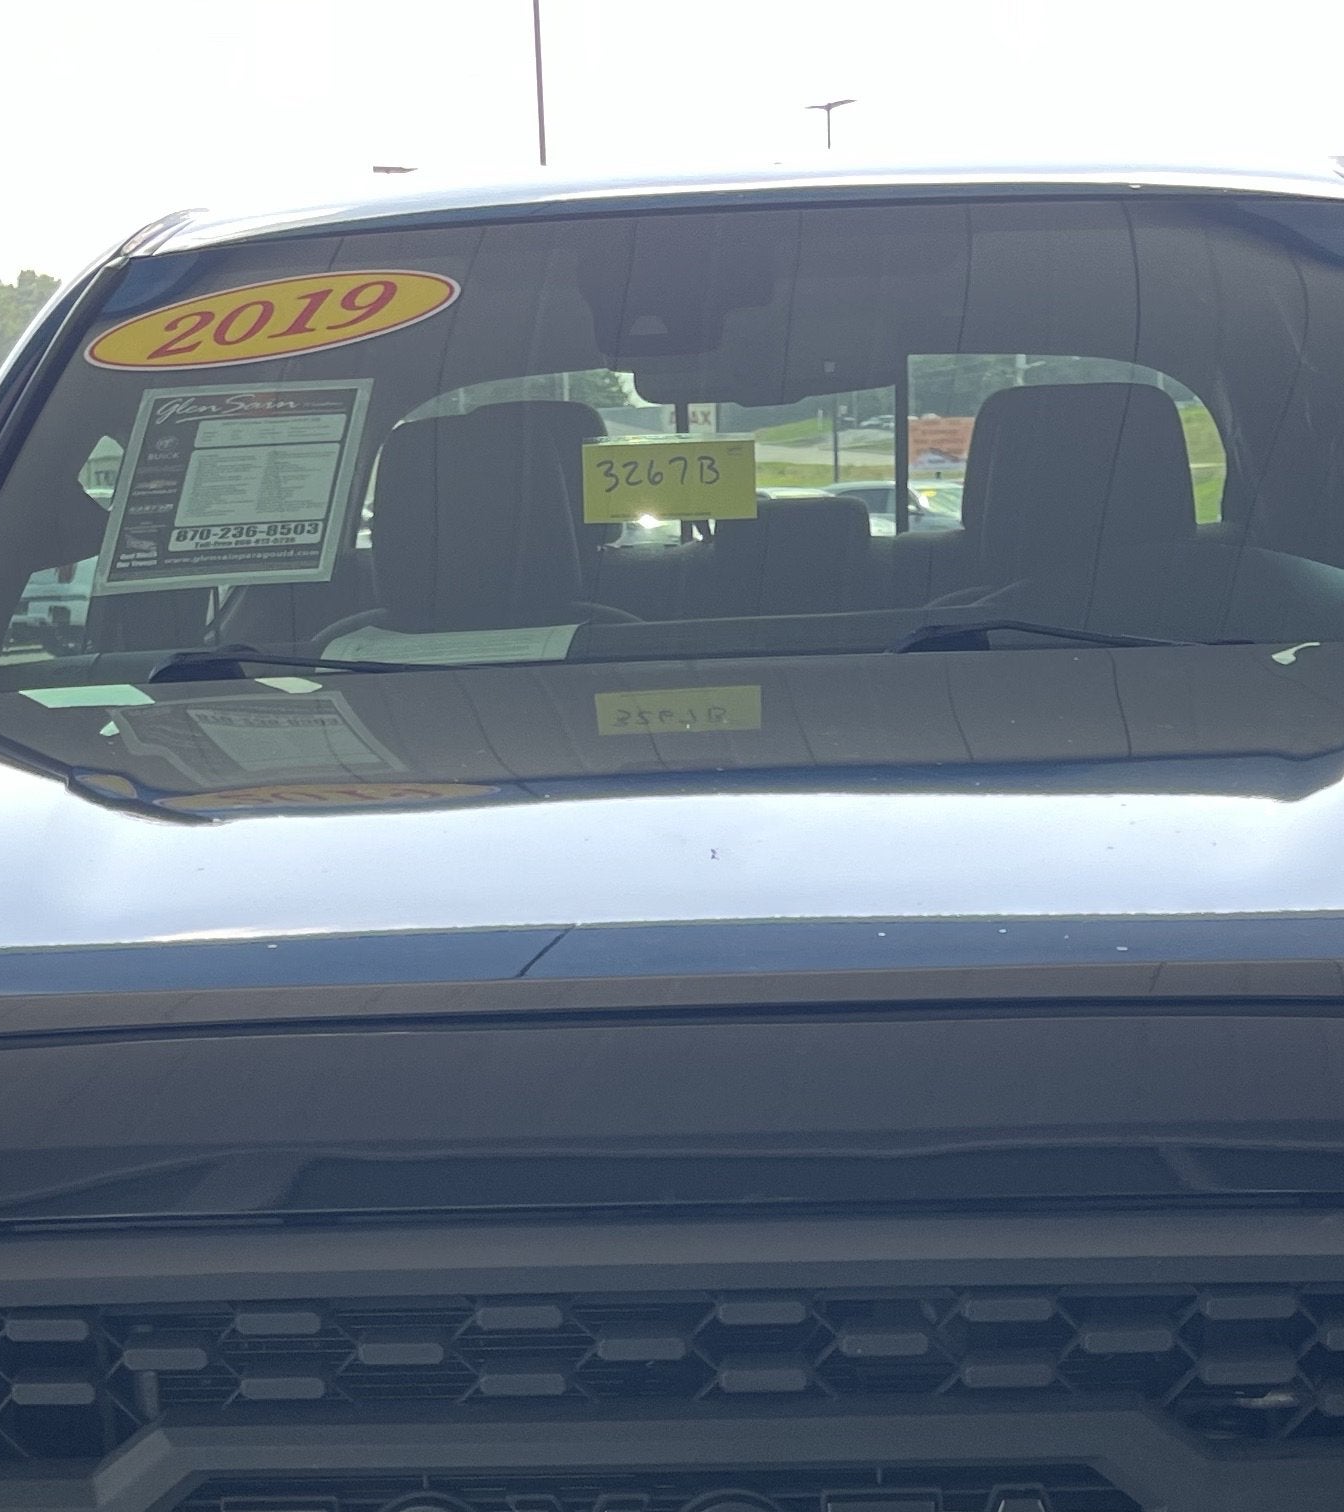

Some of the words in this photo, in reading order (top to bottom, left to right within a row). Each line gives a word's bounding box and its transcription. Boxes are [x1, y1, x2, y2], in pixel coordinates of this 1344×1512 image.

[147, 281, 398, 360] 2019
[156, 397, 222, 424] Glen
[596, 456, 720, 493] 3267B
[175, 521, 320, 541] 870-236-8503
